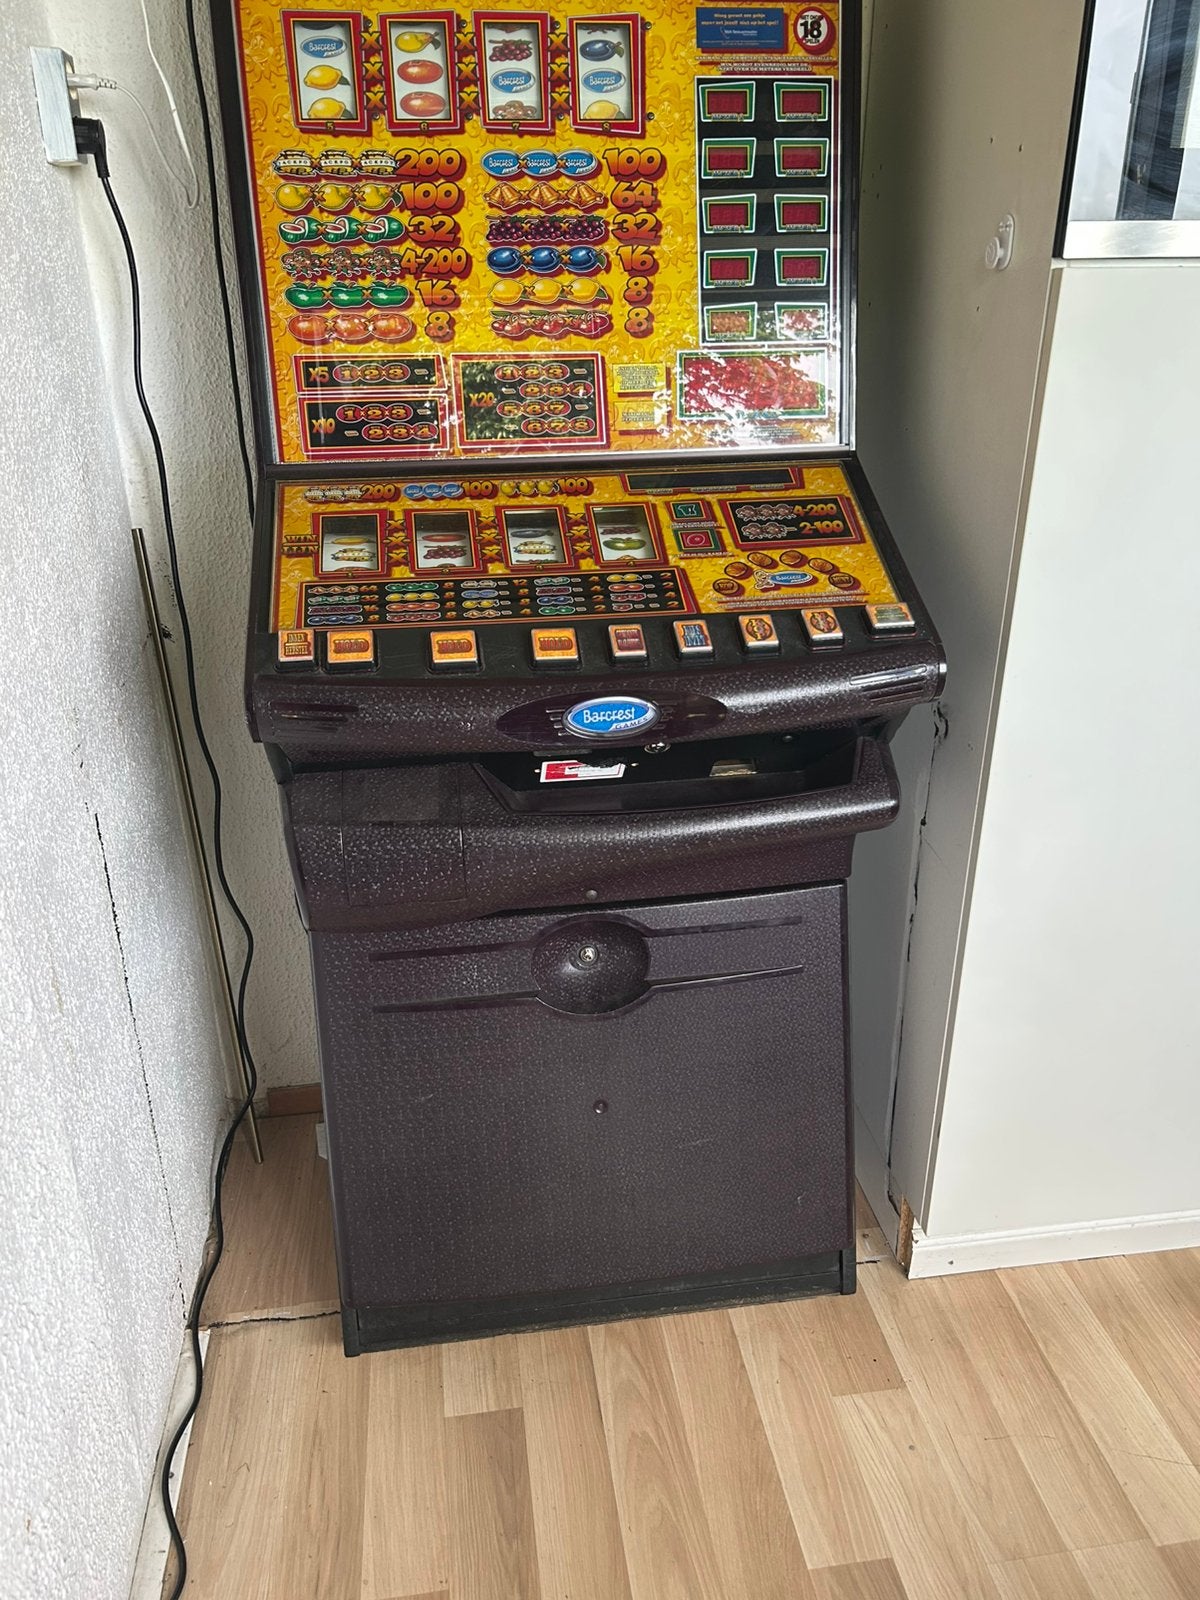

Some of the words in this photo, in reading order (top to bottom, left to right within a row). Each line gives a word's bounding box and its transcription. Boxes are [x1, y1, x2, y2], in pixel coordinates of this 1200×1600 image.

[800, 20, 822, 39] 18
[308, 41, 336, 51] Barcrest
[498, 76, 525, 85] Barcrest
[590, 76, 616, 85] Barcrest
[395, 148, 462, 177] 200
[602, 148, 662, 176] 100
[400, 182, 460, 210] 100
[611, 180, 656, 209] 64
[407, 214, 456, 242] 32
[611, 212, 658, 241] 32
[400, 247, 468, 275] 4-200
[616, 244, 655, 272] 16
[416, 279, 456, 307] 16
[623, 276, 650, 303] 8
[425, 310, 452, 338] 8
[624, 306, 650, 334] 8
[308, 366, 330, 383] X5
[340, 369, 353, 381] 1
[364, 368, 380, 380] 2
[389, 368, 404, 380] 3
[549, 368, 564, 378] 3
[469, 392, 496, 408] X20
[343, 410, 356, 421] 1
[367, 408, 382, 420] 2
[391, 408, 406, 419] 3
[550, 403, 564, 414] 7
[312, 418, 336, 434] X10
[368, 428, 384, 439] 2
[392, 428, 408, 438] 3
[417, 427, 432, 438] 4
[550, 421, 566, 432] 7
[362, 484, 396, 500] 200
[460, 481, 493, 497] 100
[556, 478, 588, 493] 100
[793, 504, 837, 518] 4-200
[799, 520, 844, 534] 2-100
[284, 534, 318, 543] WIN
[660, 572, 672, 580] 2
[334, 640, 368, 653] HOLD
[438, 640, 470, 652] HOLD
[540, 638, 572, 650] HOLD
[583, 706, 636, 724] Barcrest
